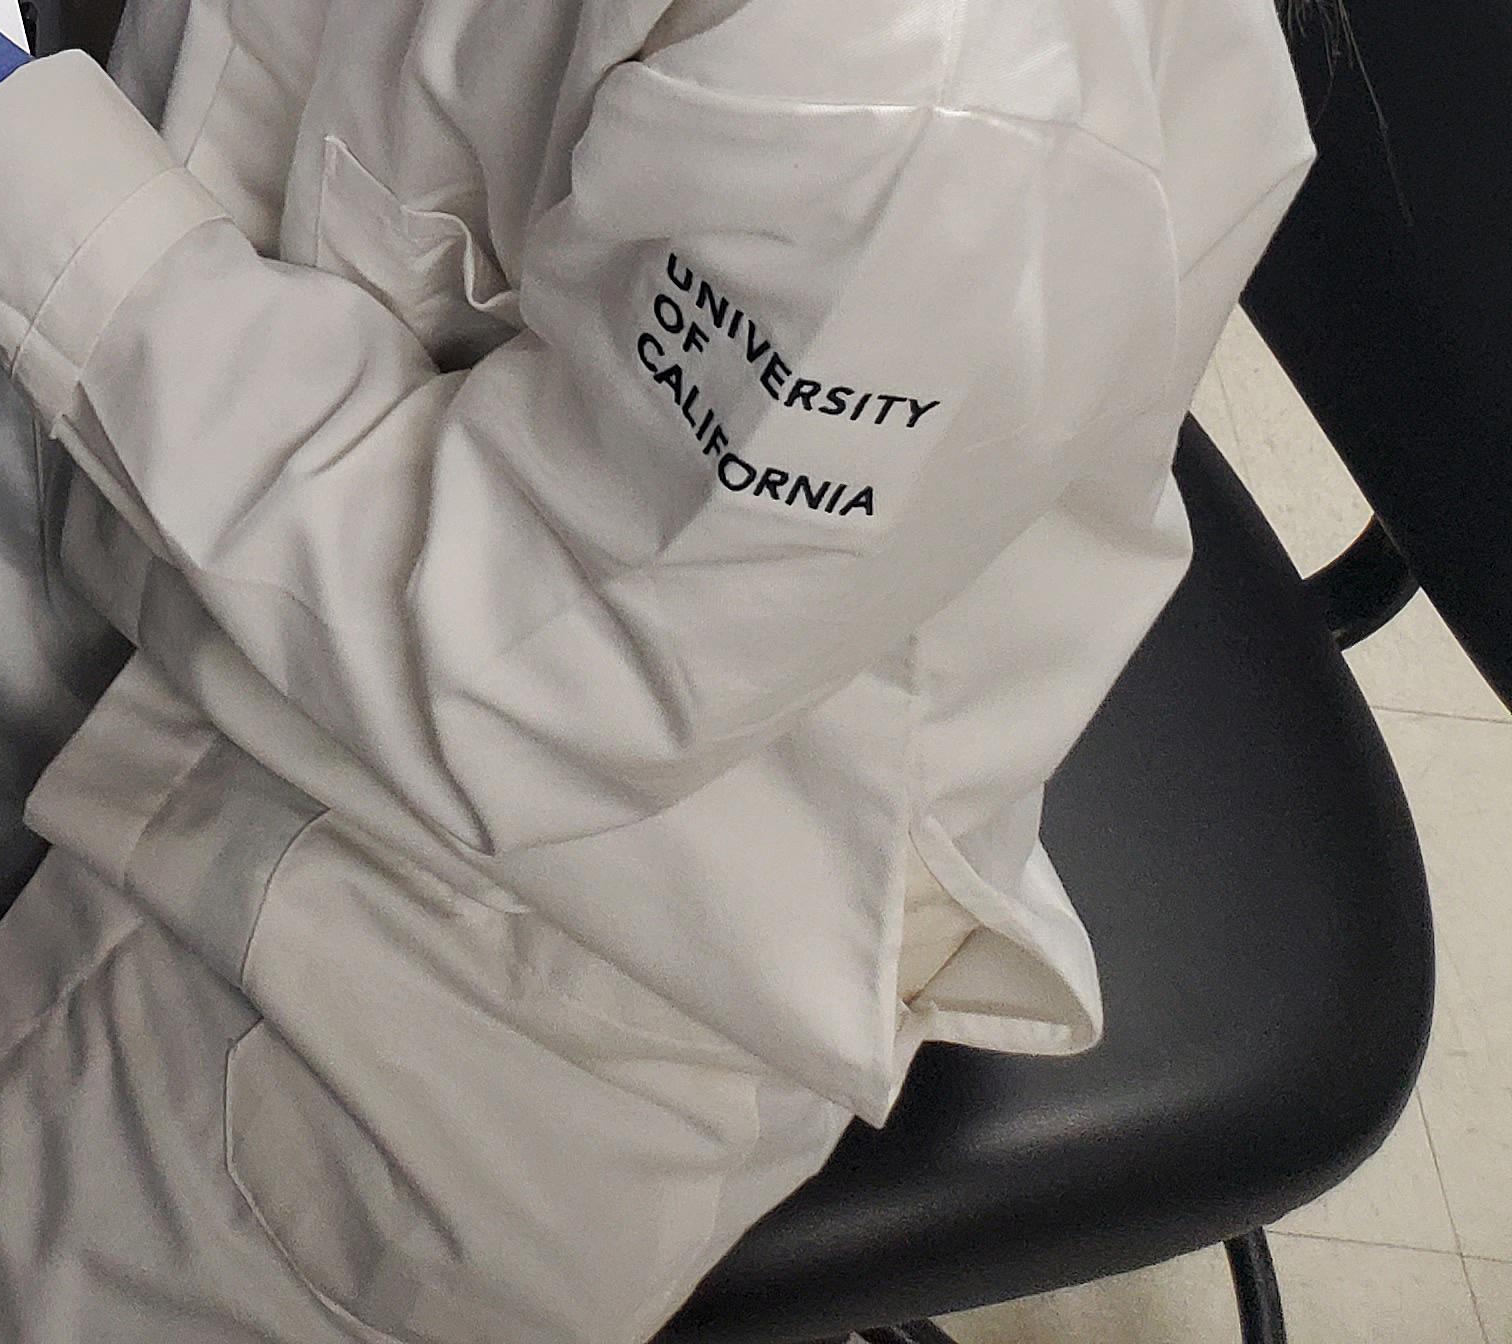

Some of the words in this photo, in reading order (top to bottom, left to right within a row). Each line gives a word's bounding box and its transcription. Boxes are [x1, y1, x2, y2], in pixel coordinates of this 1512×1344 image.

[654, 294, 710, 354] OF
[666, 253, 941, 429] UNIVERSITY
[637, 332, 874, 517] CALIFORNIA
